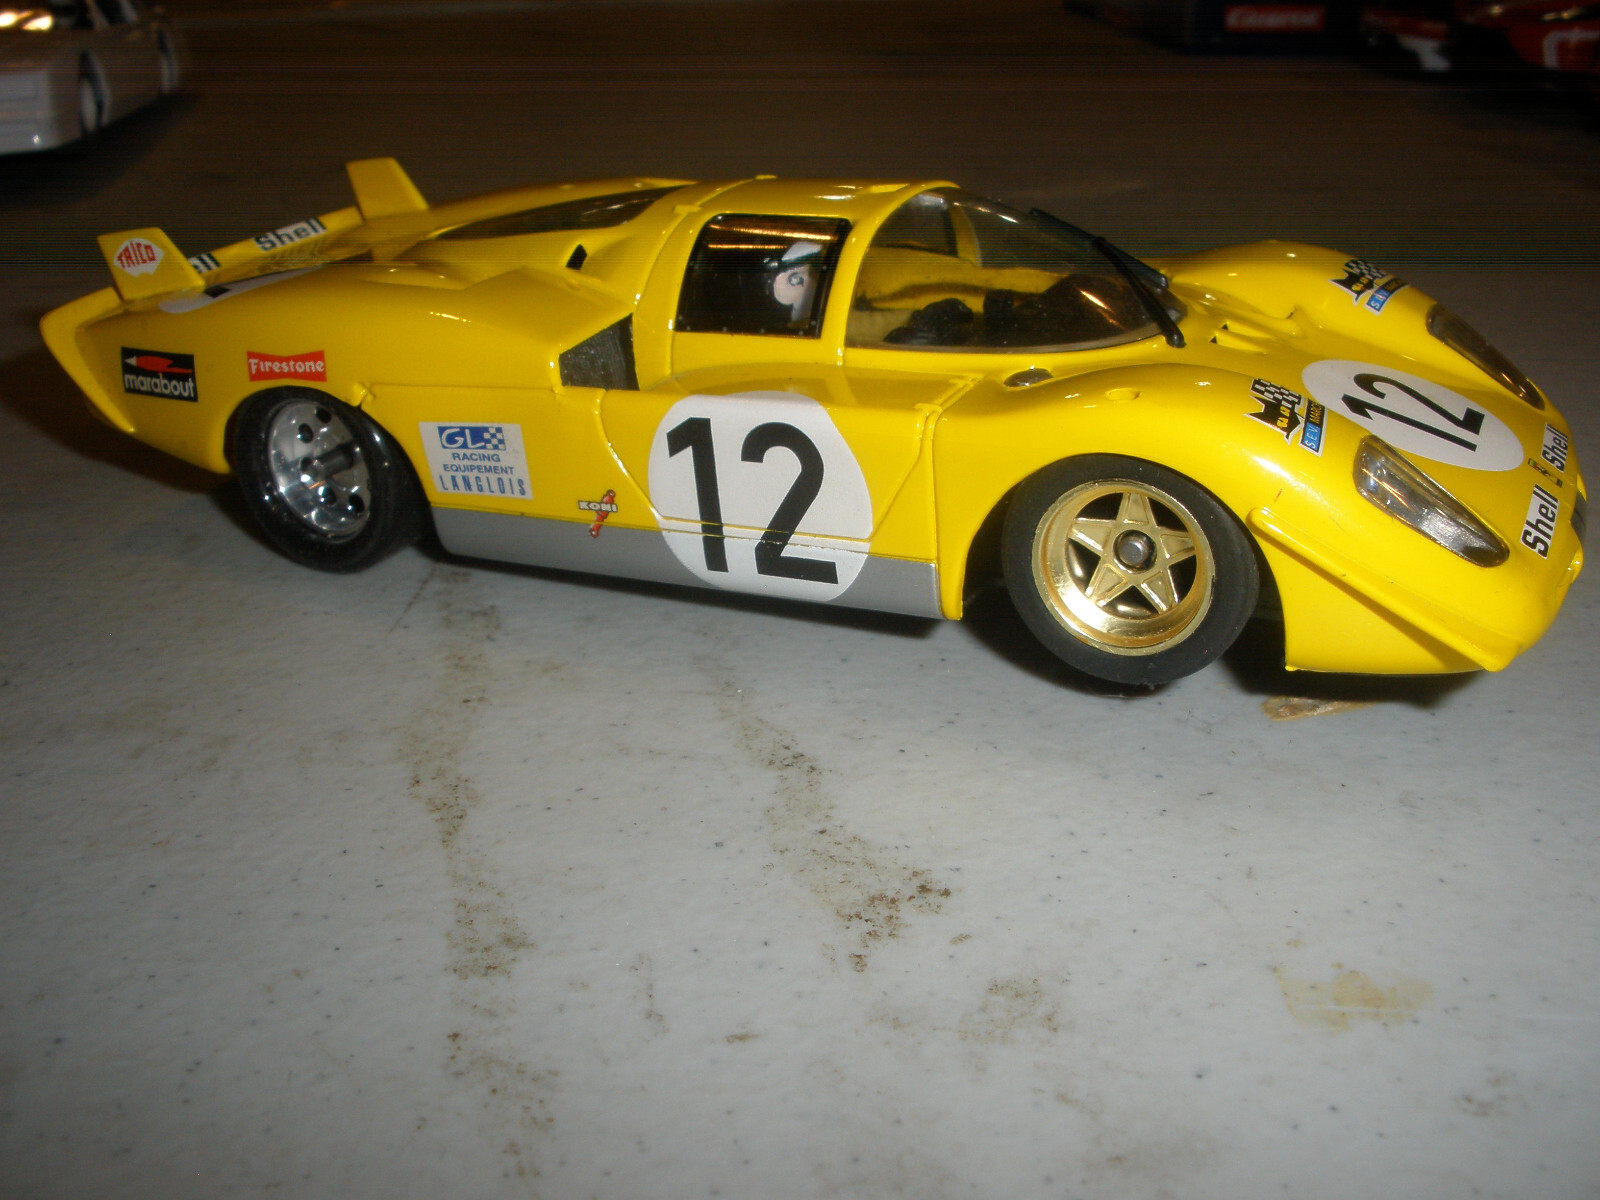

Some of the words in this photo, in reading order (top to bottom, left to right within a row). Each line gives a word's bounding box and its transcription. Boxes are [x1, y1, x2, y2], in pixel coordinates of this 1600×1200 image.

[255, 217, 327, 251] Shell
[248, 357, 325, 375] Firestone
[123, 373, 195, 398] marabout
[1341, 373, 1486, 452] 12
[441, 427, 486, 449] GL
[1542, 424, 1569, 472] Shell
[443, 463, 515, 475] EQUIPEMENT
[451, 452, 501, 463] RACING
[439, 474, 526, 496] LANGLOIS
[579, 500, 617, 513] KONI
[666, 417, 839, 584] 12
[1521, 483, 1560, 559] Shell
